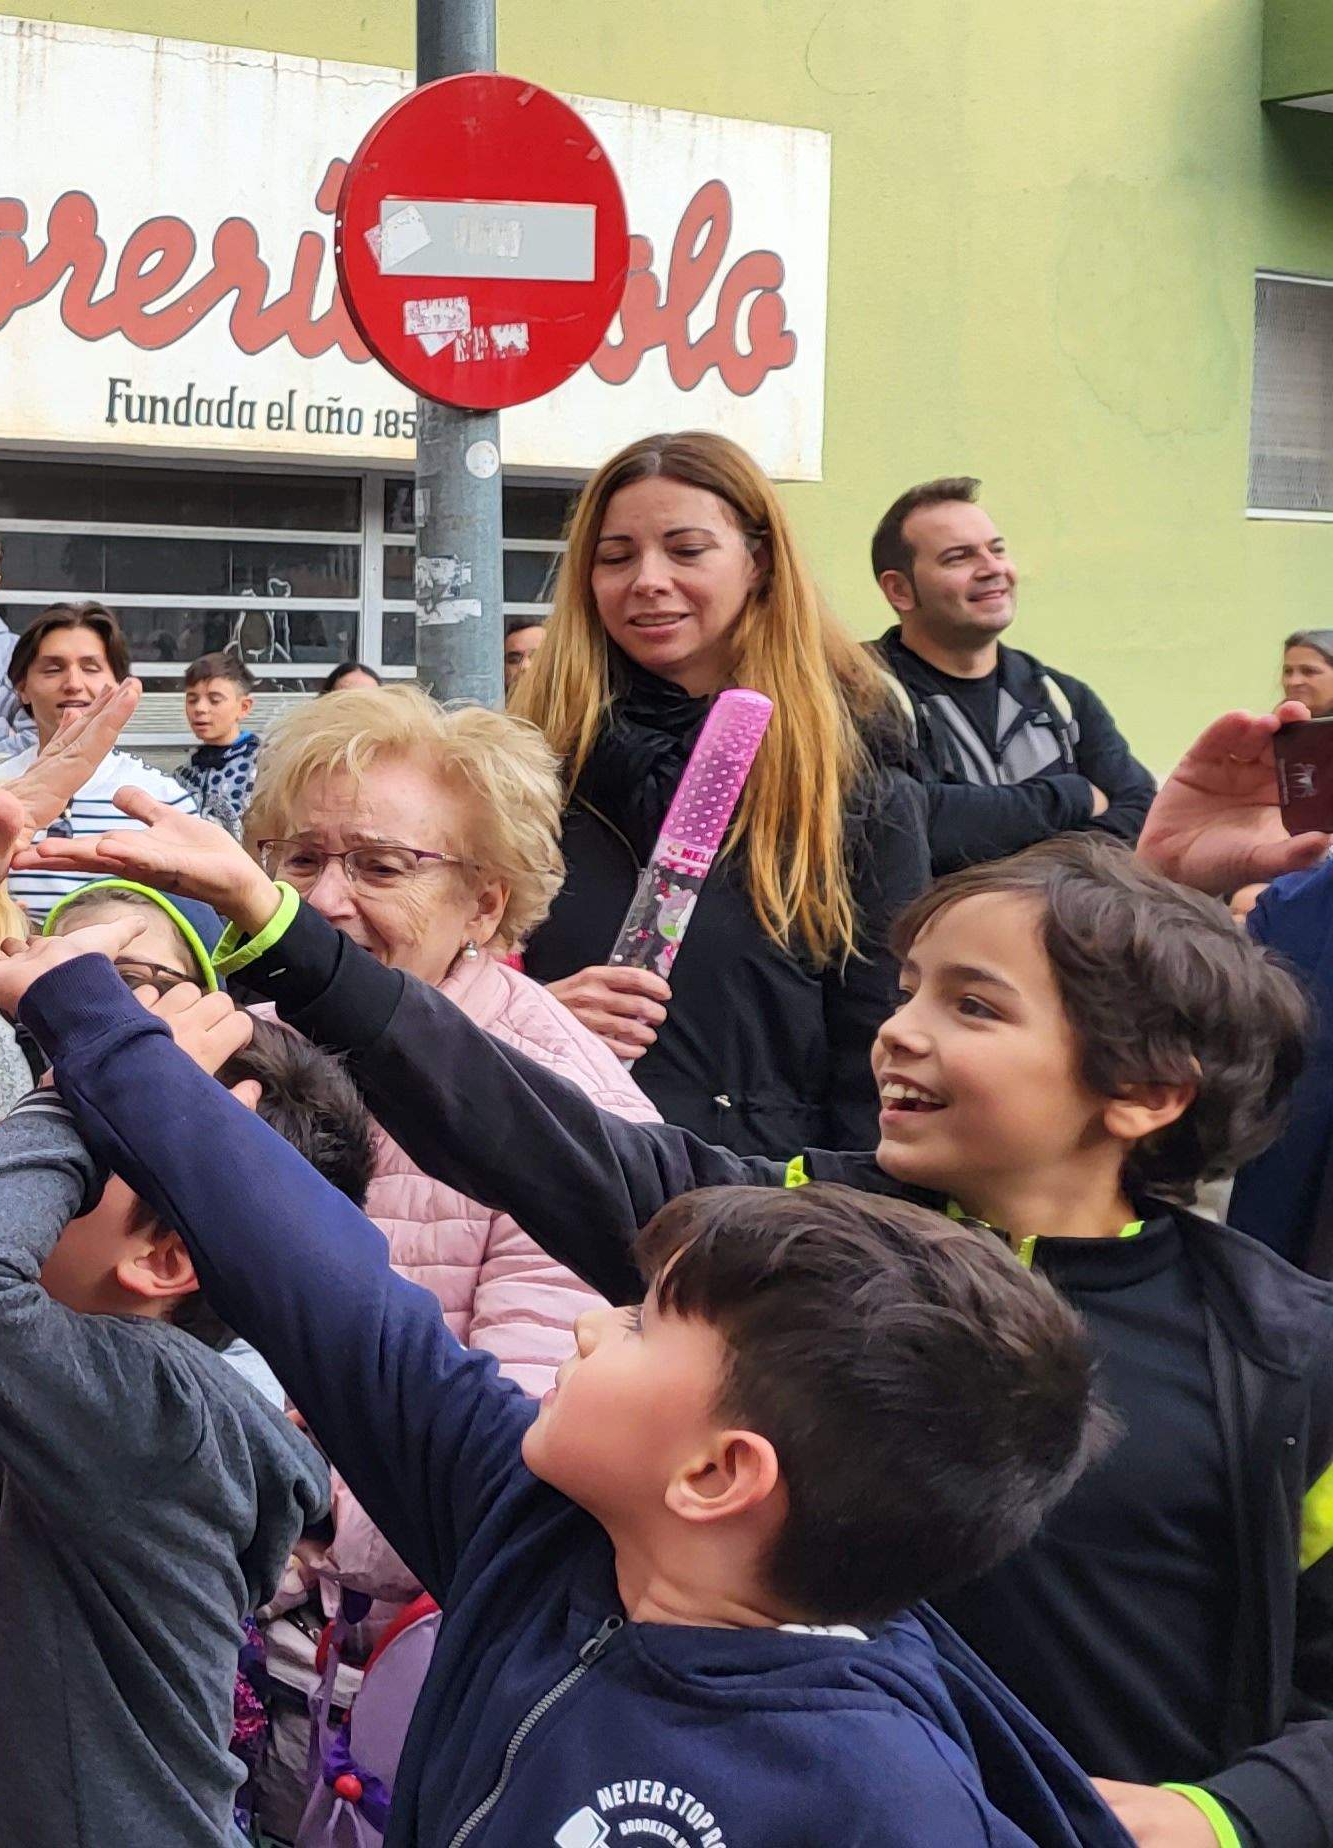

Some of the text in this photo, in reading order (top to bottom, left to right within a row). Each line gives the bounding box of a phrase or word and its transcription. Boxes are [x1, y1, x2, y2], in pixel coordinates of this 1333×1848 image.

[589, 178, 798, 397] olo
[105, 376, 417, 440] Fundada el año 185
[596, 1779, 666, 1812] NEVER
[665, 1786, 716, 1831] STOP
